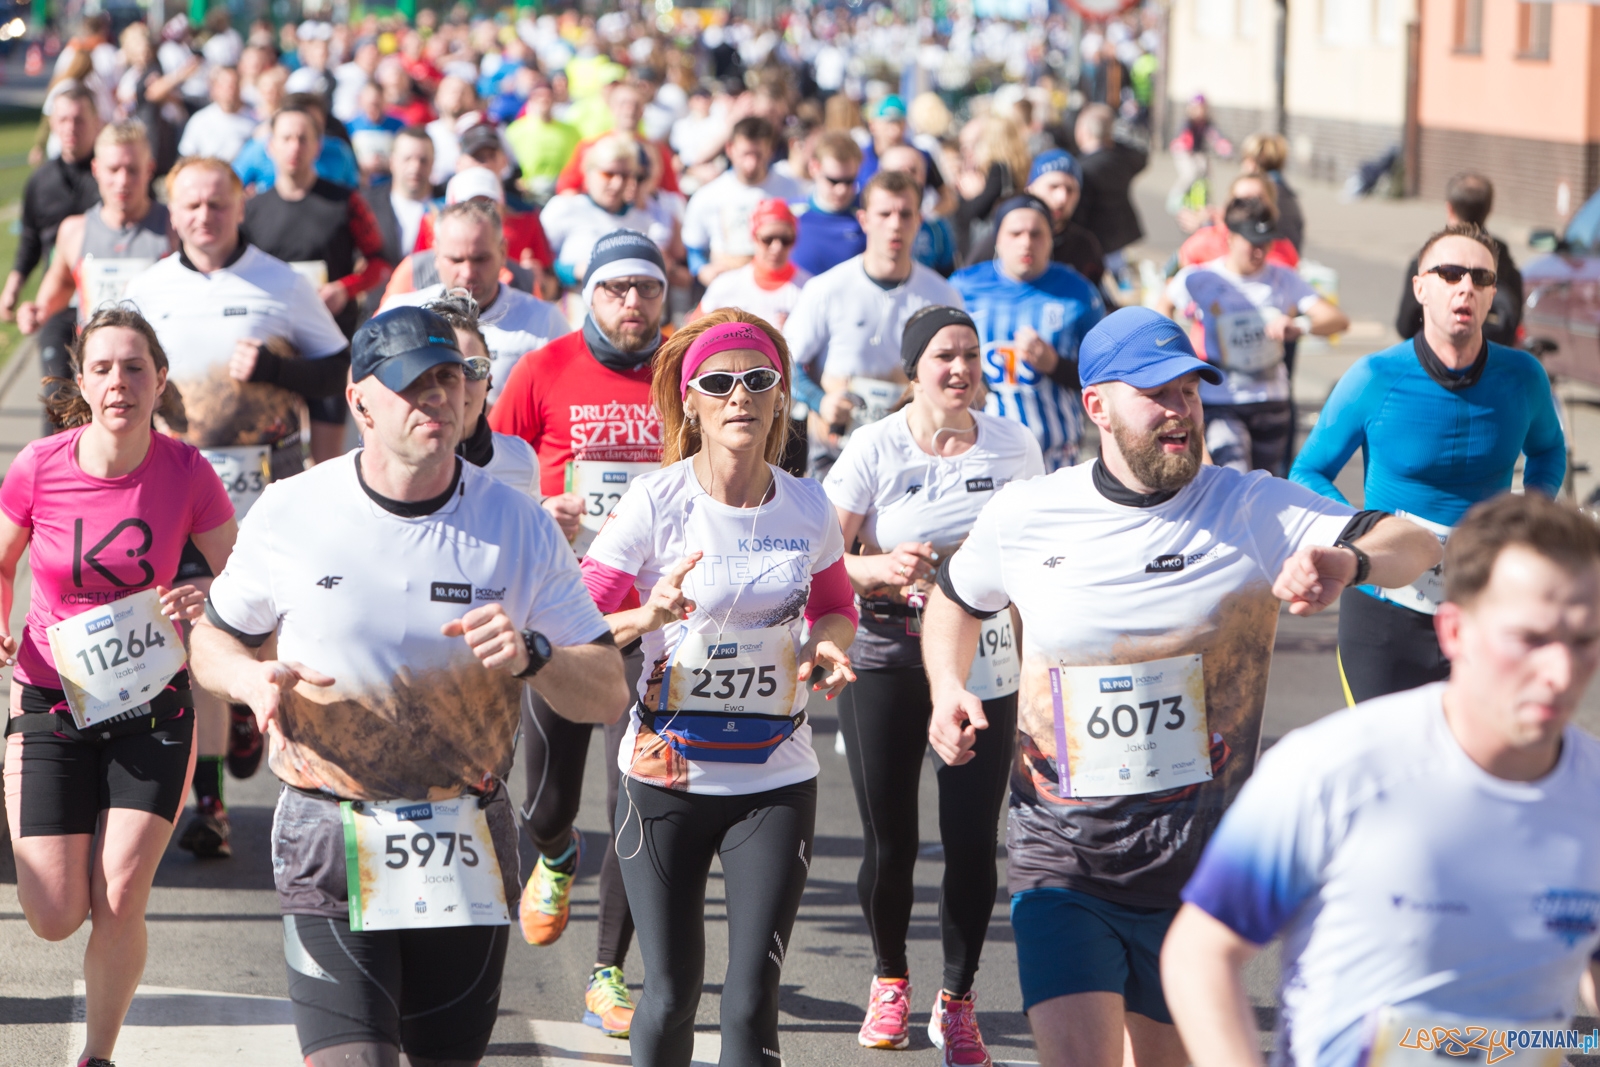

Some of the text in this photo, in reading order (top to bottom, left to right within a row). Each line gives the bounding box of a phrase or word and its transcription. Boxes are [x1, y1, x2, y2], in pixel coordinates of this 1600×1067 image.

[569, 400, 661, 421] DRUŻYNA
[738, 535, 810, 552] KOŚCIAN
[1043, 556, 1066, 569] 4F
[1150, 561, 1161, 569] 10.
[1162, 558, 1182, 568] PKO
[698, 554, 812, 586] TEAM
[316, 576, 343, 589] 4F
[61, 591, 110, 605] KOBIETY
[434, 587, 447, 598] 10.
[449, 588, 469, 598] PKO
[88, 621, 97, 632] 10.
[96, 618, 112, 630] PKO
[76, 622, 166, 676] 11264
[721, 646, 736, 656] PKO
[115, 662, 146, 679] Izabela
[690, 665, 777, 699] 2375
[1102, 681, 1112, 690] 10.
[1113, 679, 1131, 689] PKO
[723, 703, 744, 712] Ewa
[1086, 695, 1186, 740] 6073
[1124, 741, 1158, 753] Jakub
[411, 808, 430, 817] PKO
[385, 832, 480, 870] 5975
[422, 874, 455, 885] Jacek
